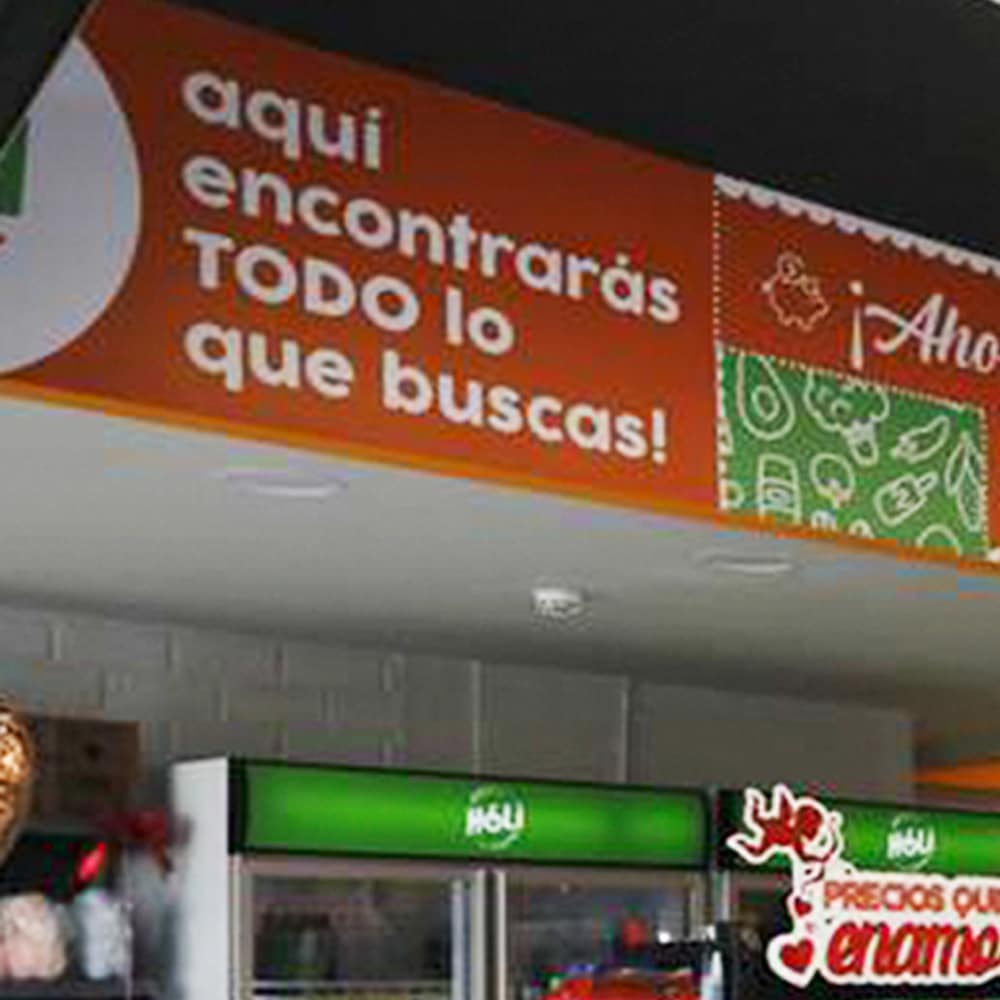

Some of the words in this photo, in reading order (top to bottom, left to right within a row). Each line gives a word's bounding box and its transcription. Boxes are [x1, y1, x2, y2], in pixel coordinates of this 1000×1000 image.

[182, 153, 681, 324] encontrarás
[183, 228, 421, 333] TODO
[446, 287, 515, 356] lo
[184, 321, 355, 396] que
[382, 349, 667, 464] buscas!
[824, 880, 944, 912] PRECIOS
